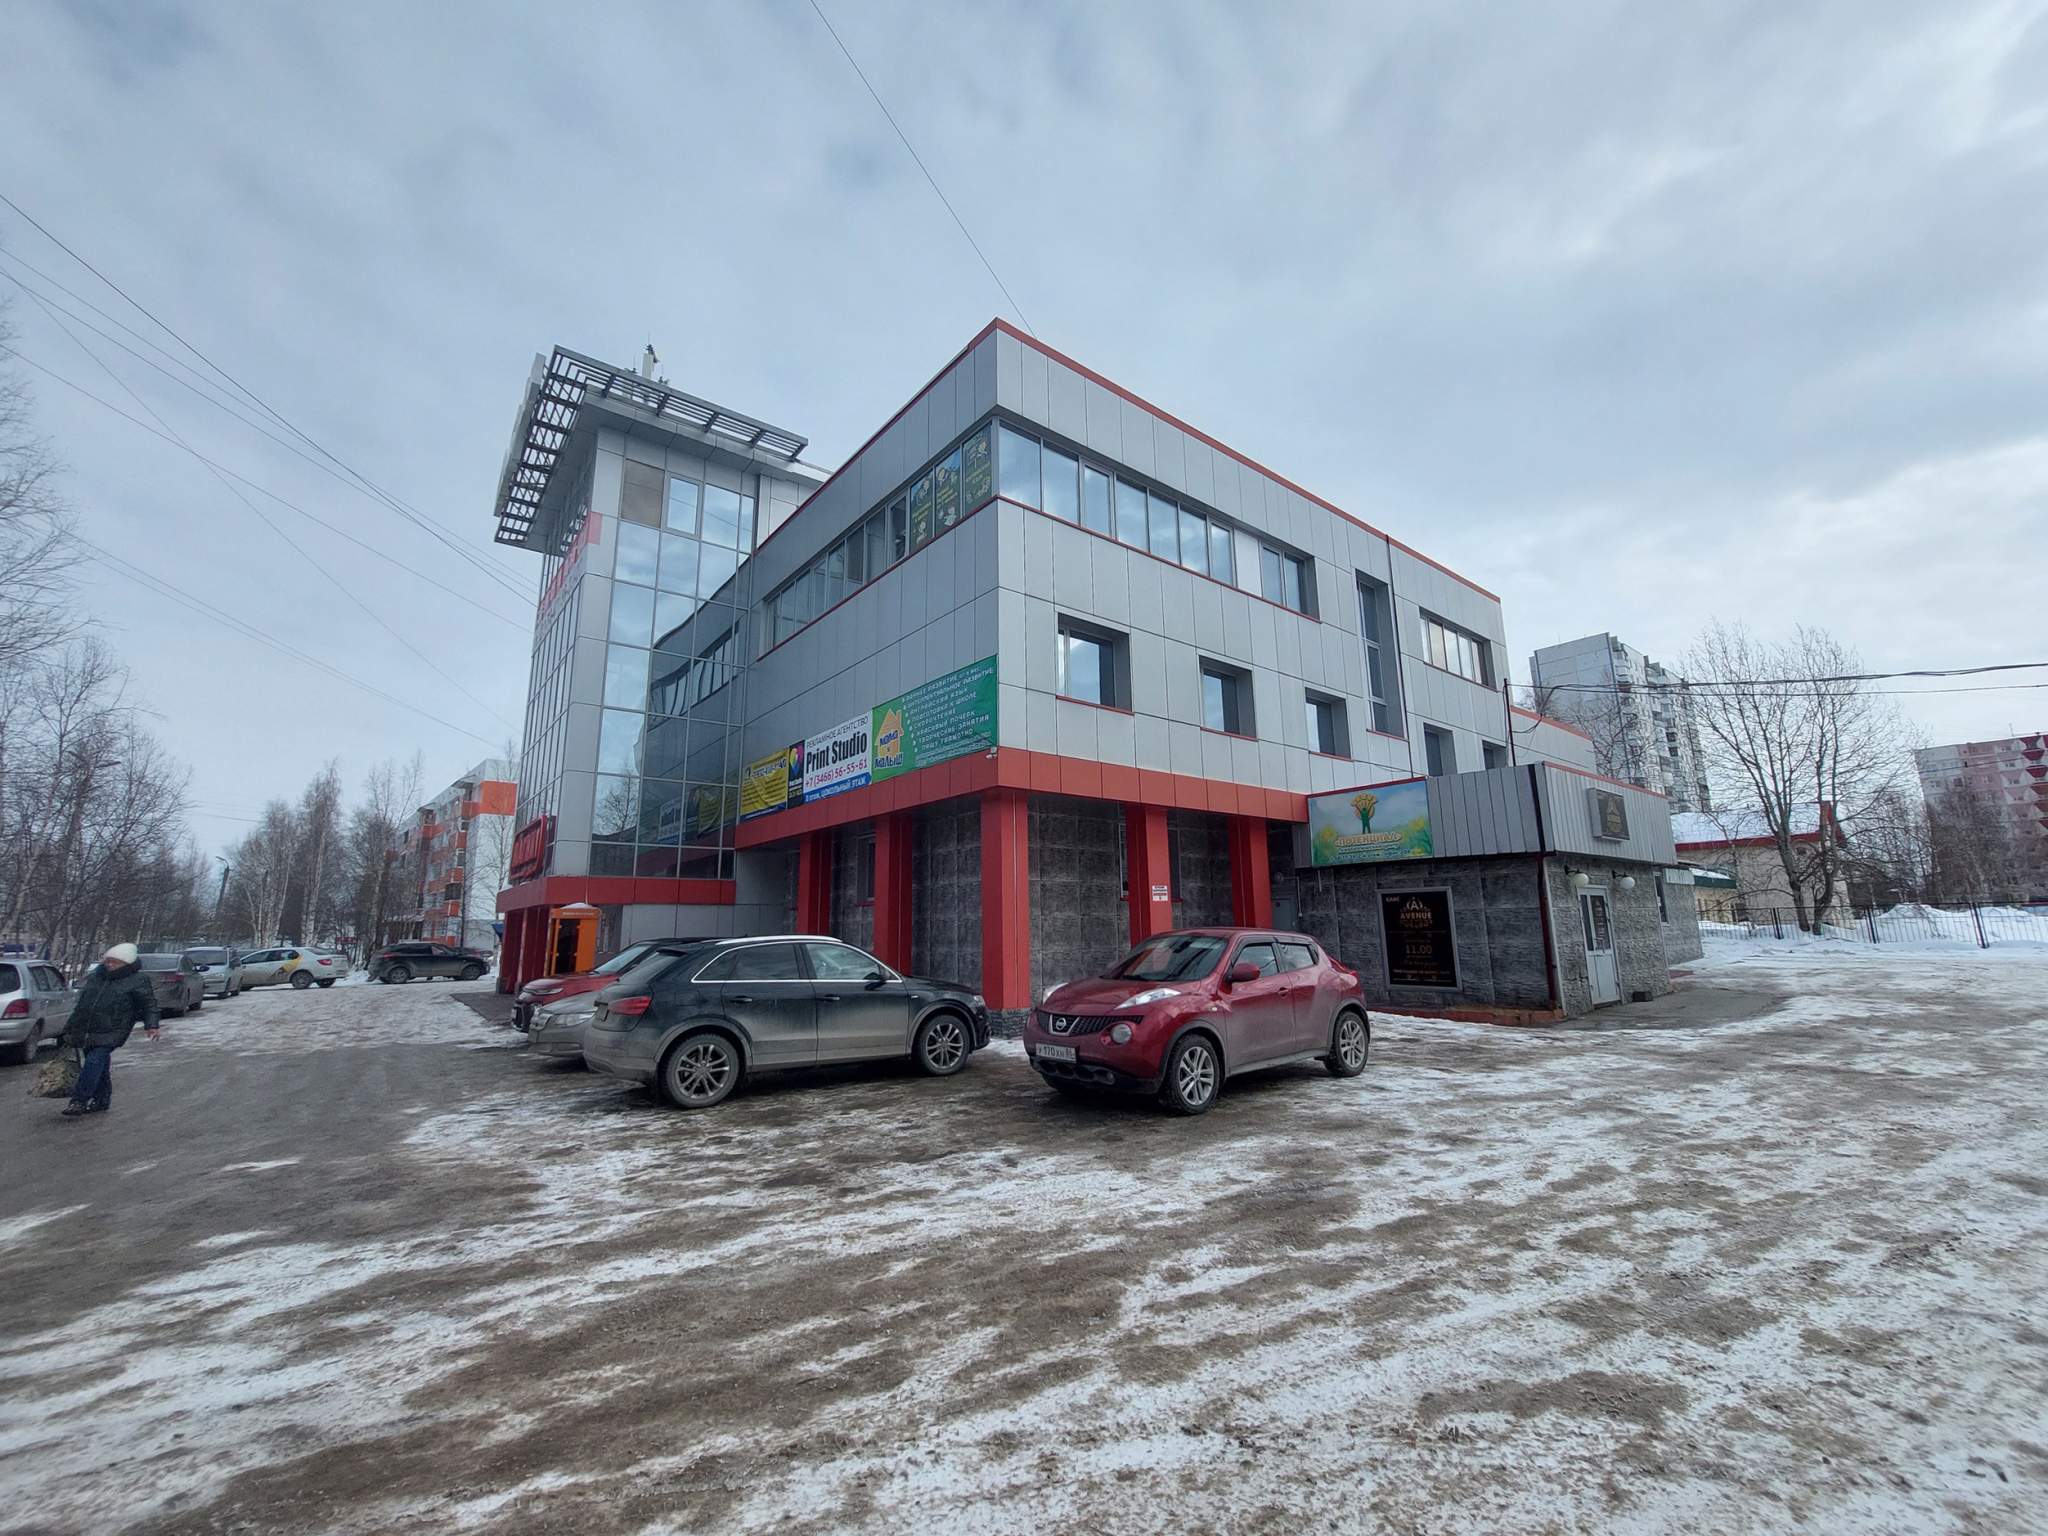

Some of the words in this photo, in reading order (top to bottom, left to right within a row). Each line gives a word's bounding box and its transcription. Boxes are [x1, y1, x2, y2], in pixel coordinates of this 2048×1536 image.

[964, 667, 992, 684] РАЗВИТИЕ
[951, 710, 975, 723] ПОЧЕРК
[958, 715, 989, 729] ЗАНЯТИЯ
[941, 728, 973, 743] ГРАМОТНО
[807, 746, 829, 774] Print
[832, 731, 867, 764] Studio
[835, 759, 867, 778] 56-55-61
[1401, 911, 1432, 920] AVENUE
